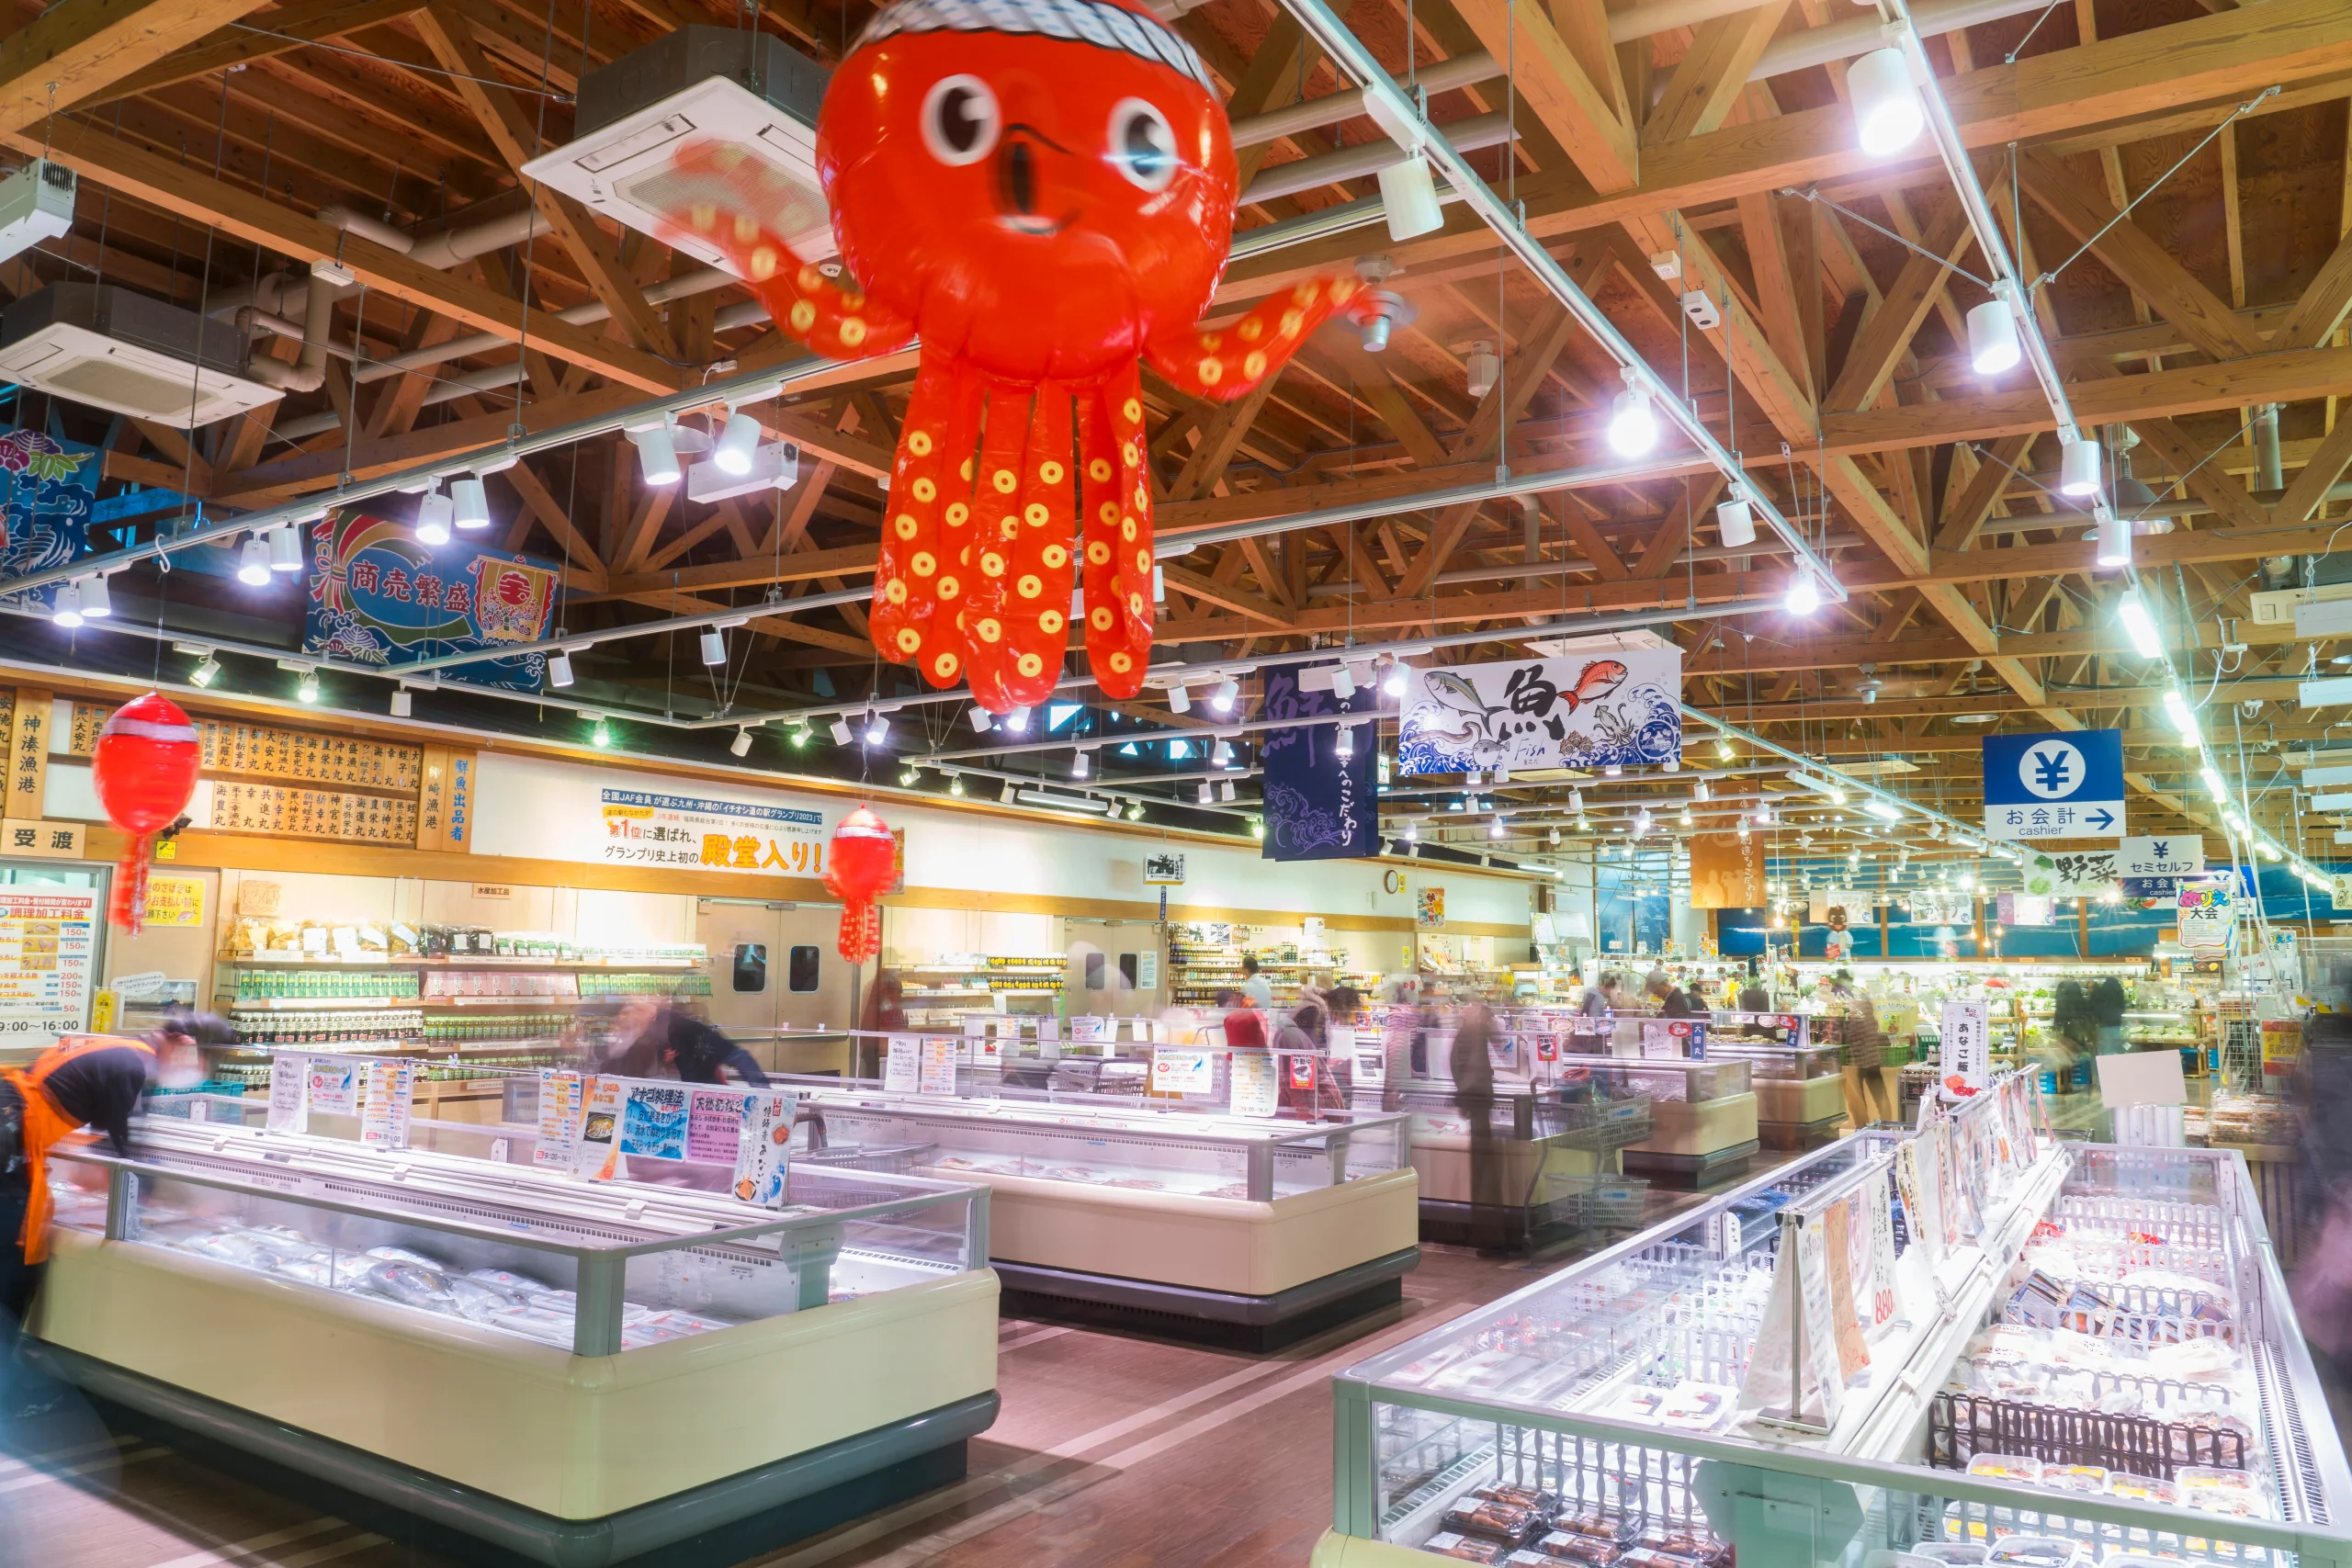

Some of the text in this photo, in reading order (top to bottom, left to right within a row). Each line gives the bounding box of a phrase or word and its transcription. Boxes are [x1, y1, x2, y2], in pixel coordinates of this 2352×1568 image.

[352, 559, 470, 615] 商売繁盛
[1498, 664, 1566, 741] 魚
[74, 705, 89, 752] 第八大安丸
[18, 715, 41, 794] 神湊漁港
[263, 730, 276, 772] 大安丸
[292, 736, 304, 776] 第一金光丸
[306, 738, 318, 778] 海幸丸
[346, 742, 357, 782] 盛漁丸
[1514, 737, 1545, 761] Fish
[410, 750, 421, 788] 大国丸
[258, 789, 271, 829] 共進丸
[288, 791, 299, 831] 第八神宮丸
[314, 794, 327, 834] 新幸丸
[329, 795, 341, 834] 神宮丸
[356, 797, 367, 837] 海運丸
[381, 800, 391, 839] 明神丸
[450, 759, 469, 842] 鮮魚出品者
[657, 813, 680, 821] 3年連続
[2007, 807, 2076, 826] お会計
[15, 829, 74, 851] 受渡
[2018, 825, 2064, 836] cashier
[605, 845, 699, 864] グランプリ史上初の
[2055, 854, 2118, 885] 野菜
[2131, 862, 2194, 874] セミセルフ
[477, 886, 510, 897] 水産加工品
[2178, 889, 2230, 908] ぬりえ
[9, 908, 85, 919] 調理加工料金
[2190, 908, 2218, 919] 大会
[61, 972, 83, 980] 200円
[1957, 1022, 1969, 1072] あなご飯
[630, 1087, 684, 1107] アナゴ処理法
